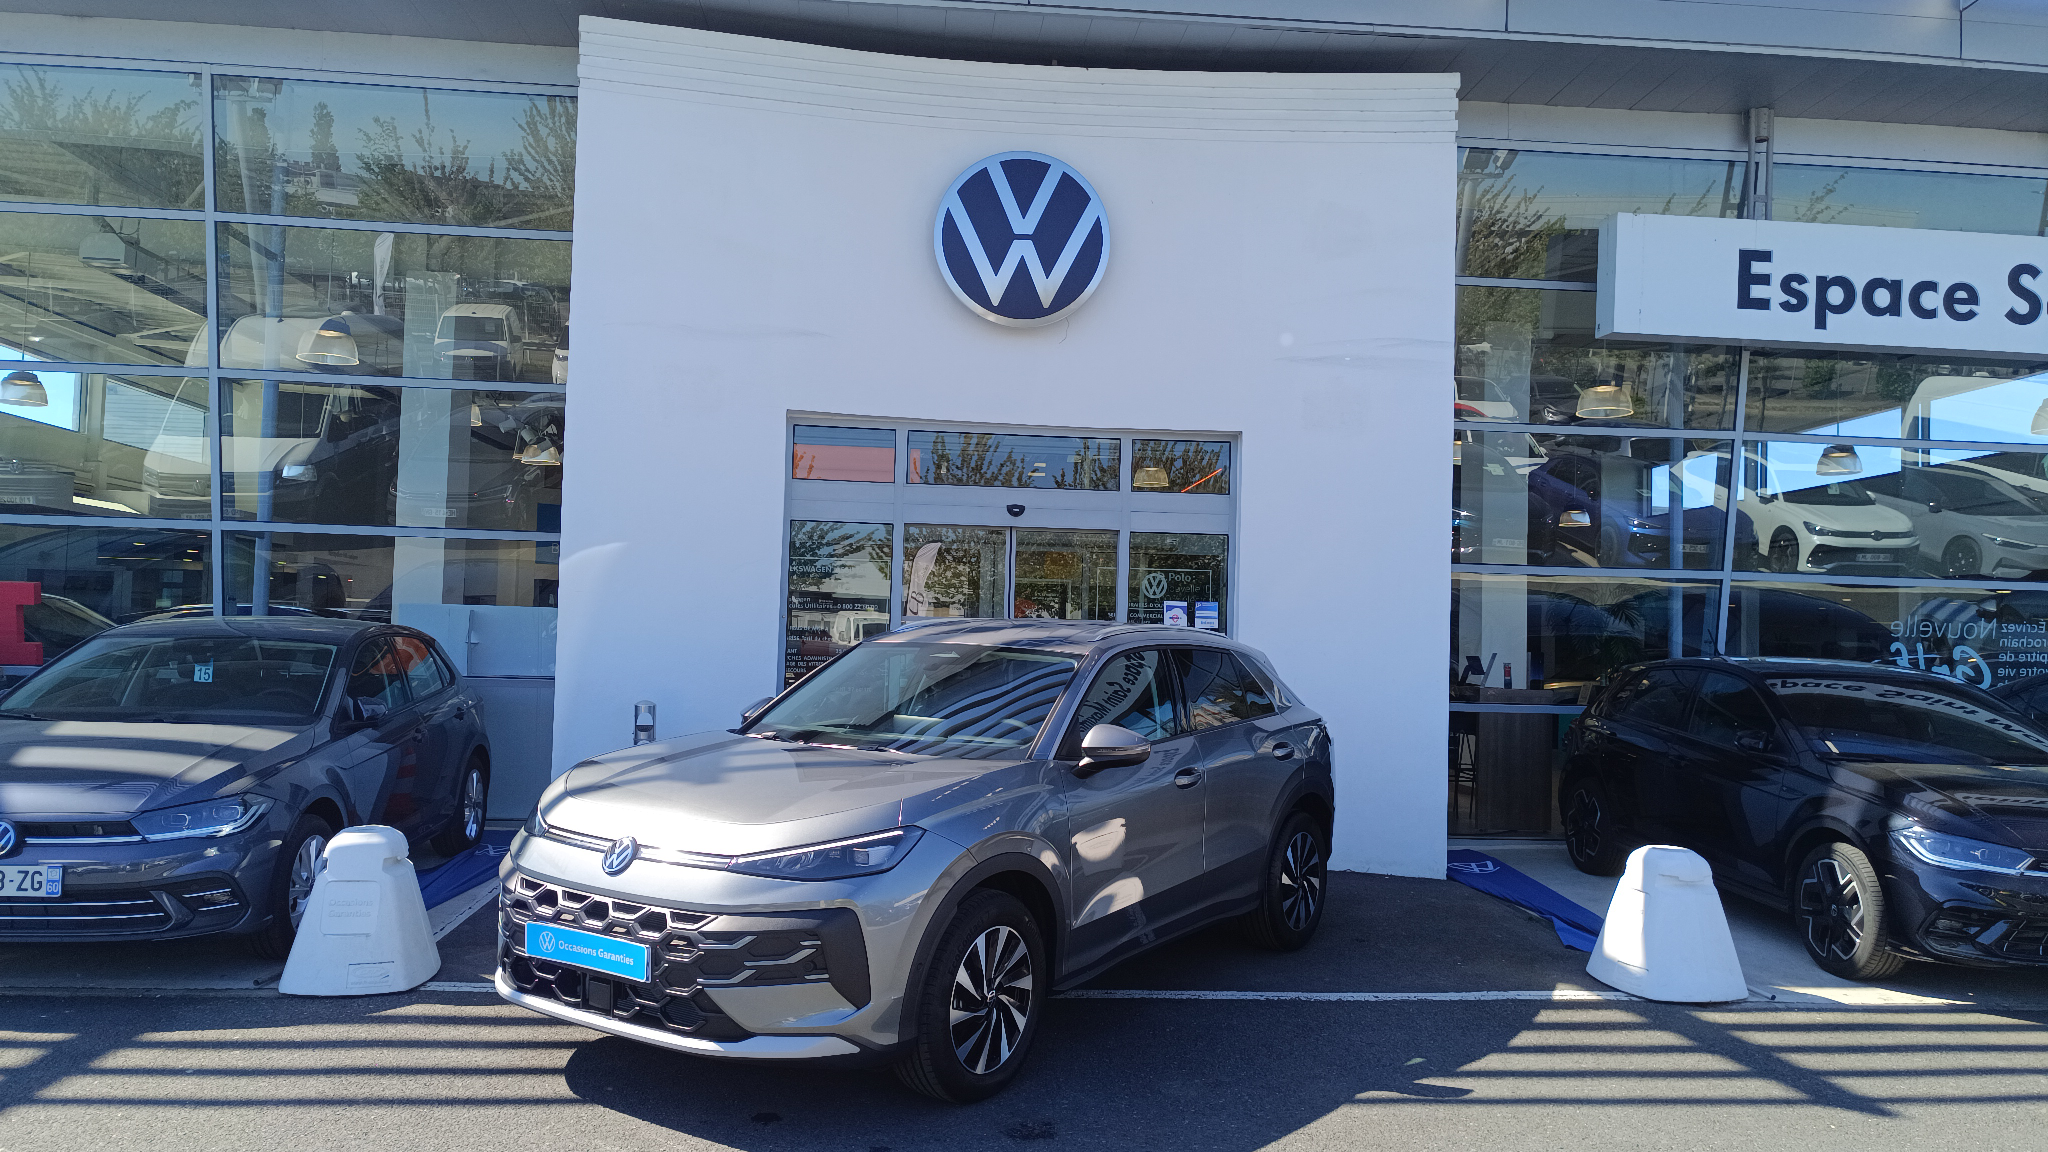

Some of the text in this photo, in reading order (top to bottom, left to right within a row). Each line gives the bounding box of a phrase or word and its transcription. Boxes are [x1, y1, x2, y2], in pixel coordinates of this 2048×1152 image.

[1737, 248, 2048, 330] Espace S
[196, 667, 211, 682] 15
[46, 882, 59, 893] 60
[328, 898, 373, 907] Occasions
[328, 909, 371, 918] Garanties
[558, 940, 597, 957] Occasions
[598, 948, 634, 966] Garanties
